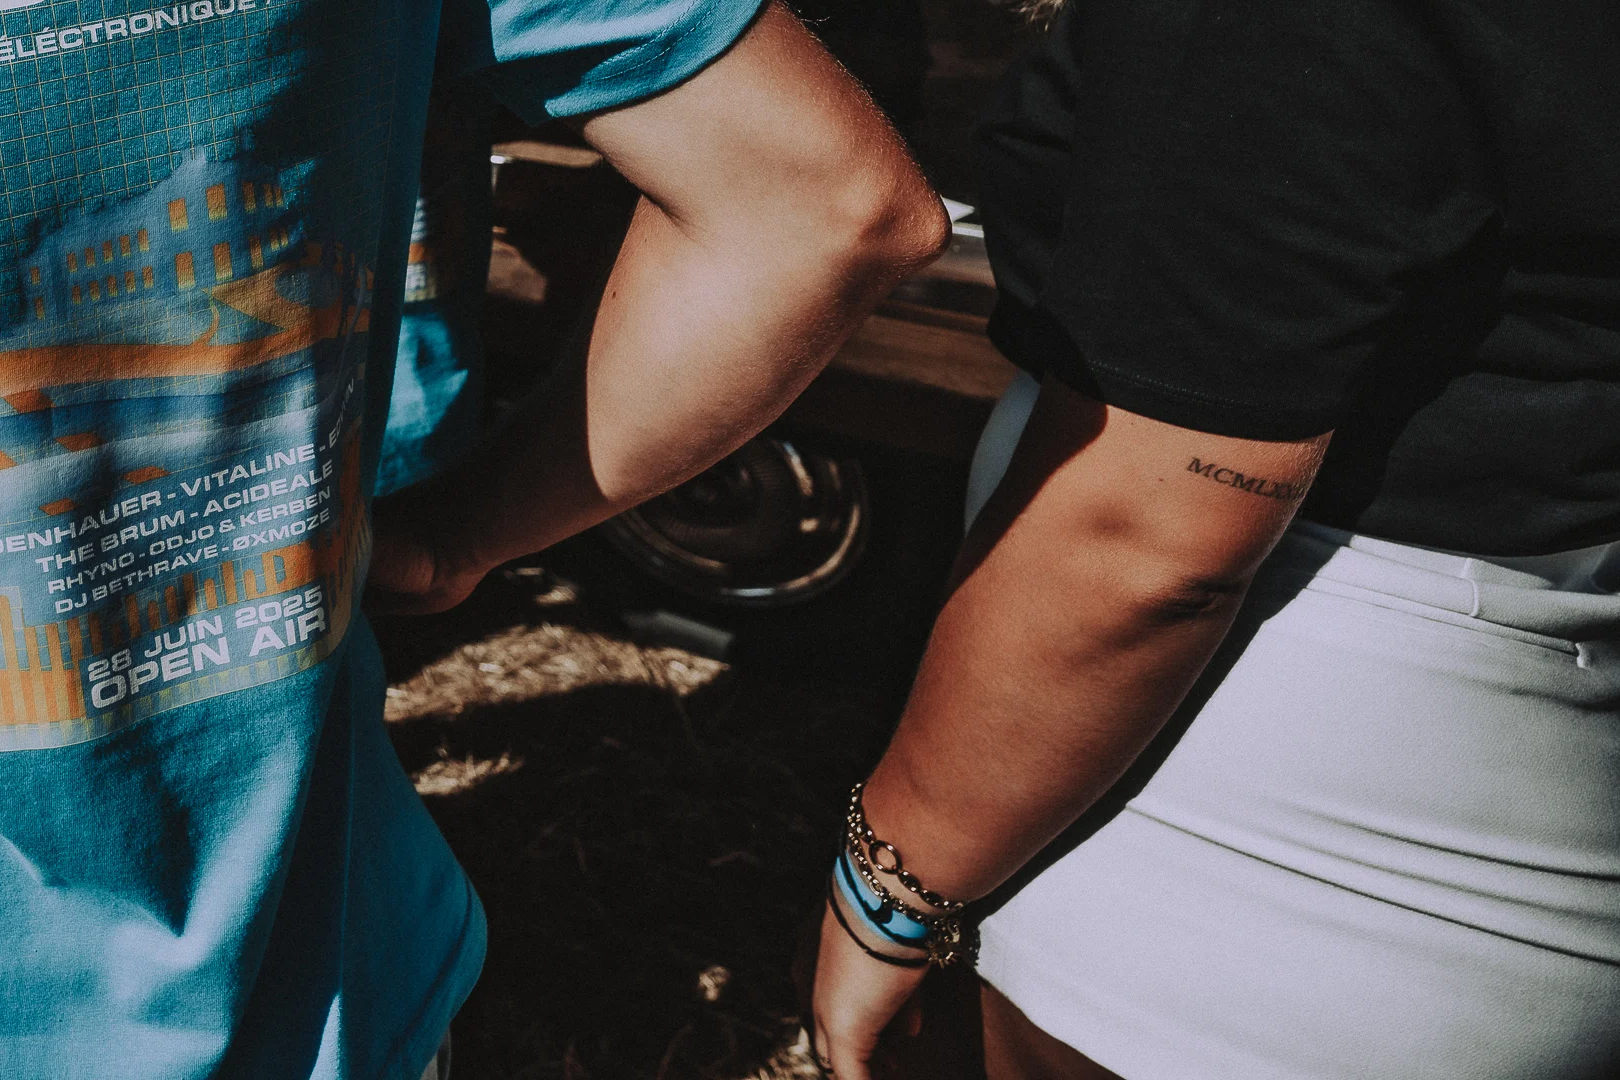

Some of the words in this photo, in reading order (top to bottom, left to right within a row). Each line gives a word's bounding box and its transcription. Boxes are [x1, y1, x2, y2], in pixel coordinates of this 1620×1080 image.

[35, 542, 95, 573] THE
[100, 509, 185, 553] BRUM
[203, 459, 333, 518] ACIDEALE
[180, 443, 315, 497] VITALINE
[48, 551, 135, 594] RHYNO
[149, 525, 215, 556] ODJO
[219, 519, 236, 533] &
[239, 485, 330, 528] KERBEN
[55, 592, 88, 614] DJ
[93, 544, 219, 602] BETHRAVE
[87, 648, 133, 683] 28
[145, 615, 223, 658] JUIN
[235, 585, 323, 629] 2025
[91, 637, 230, 709] OPEN
[249, 606, 326, 657] AIR
